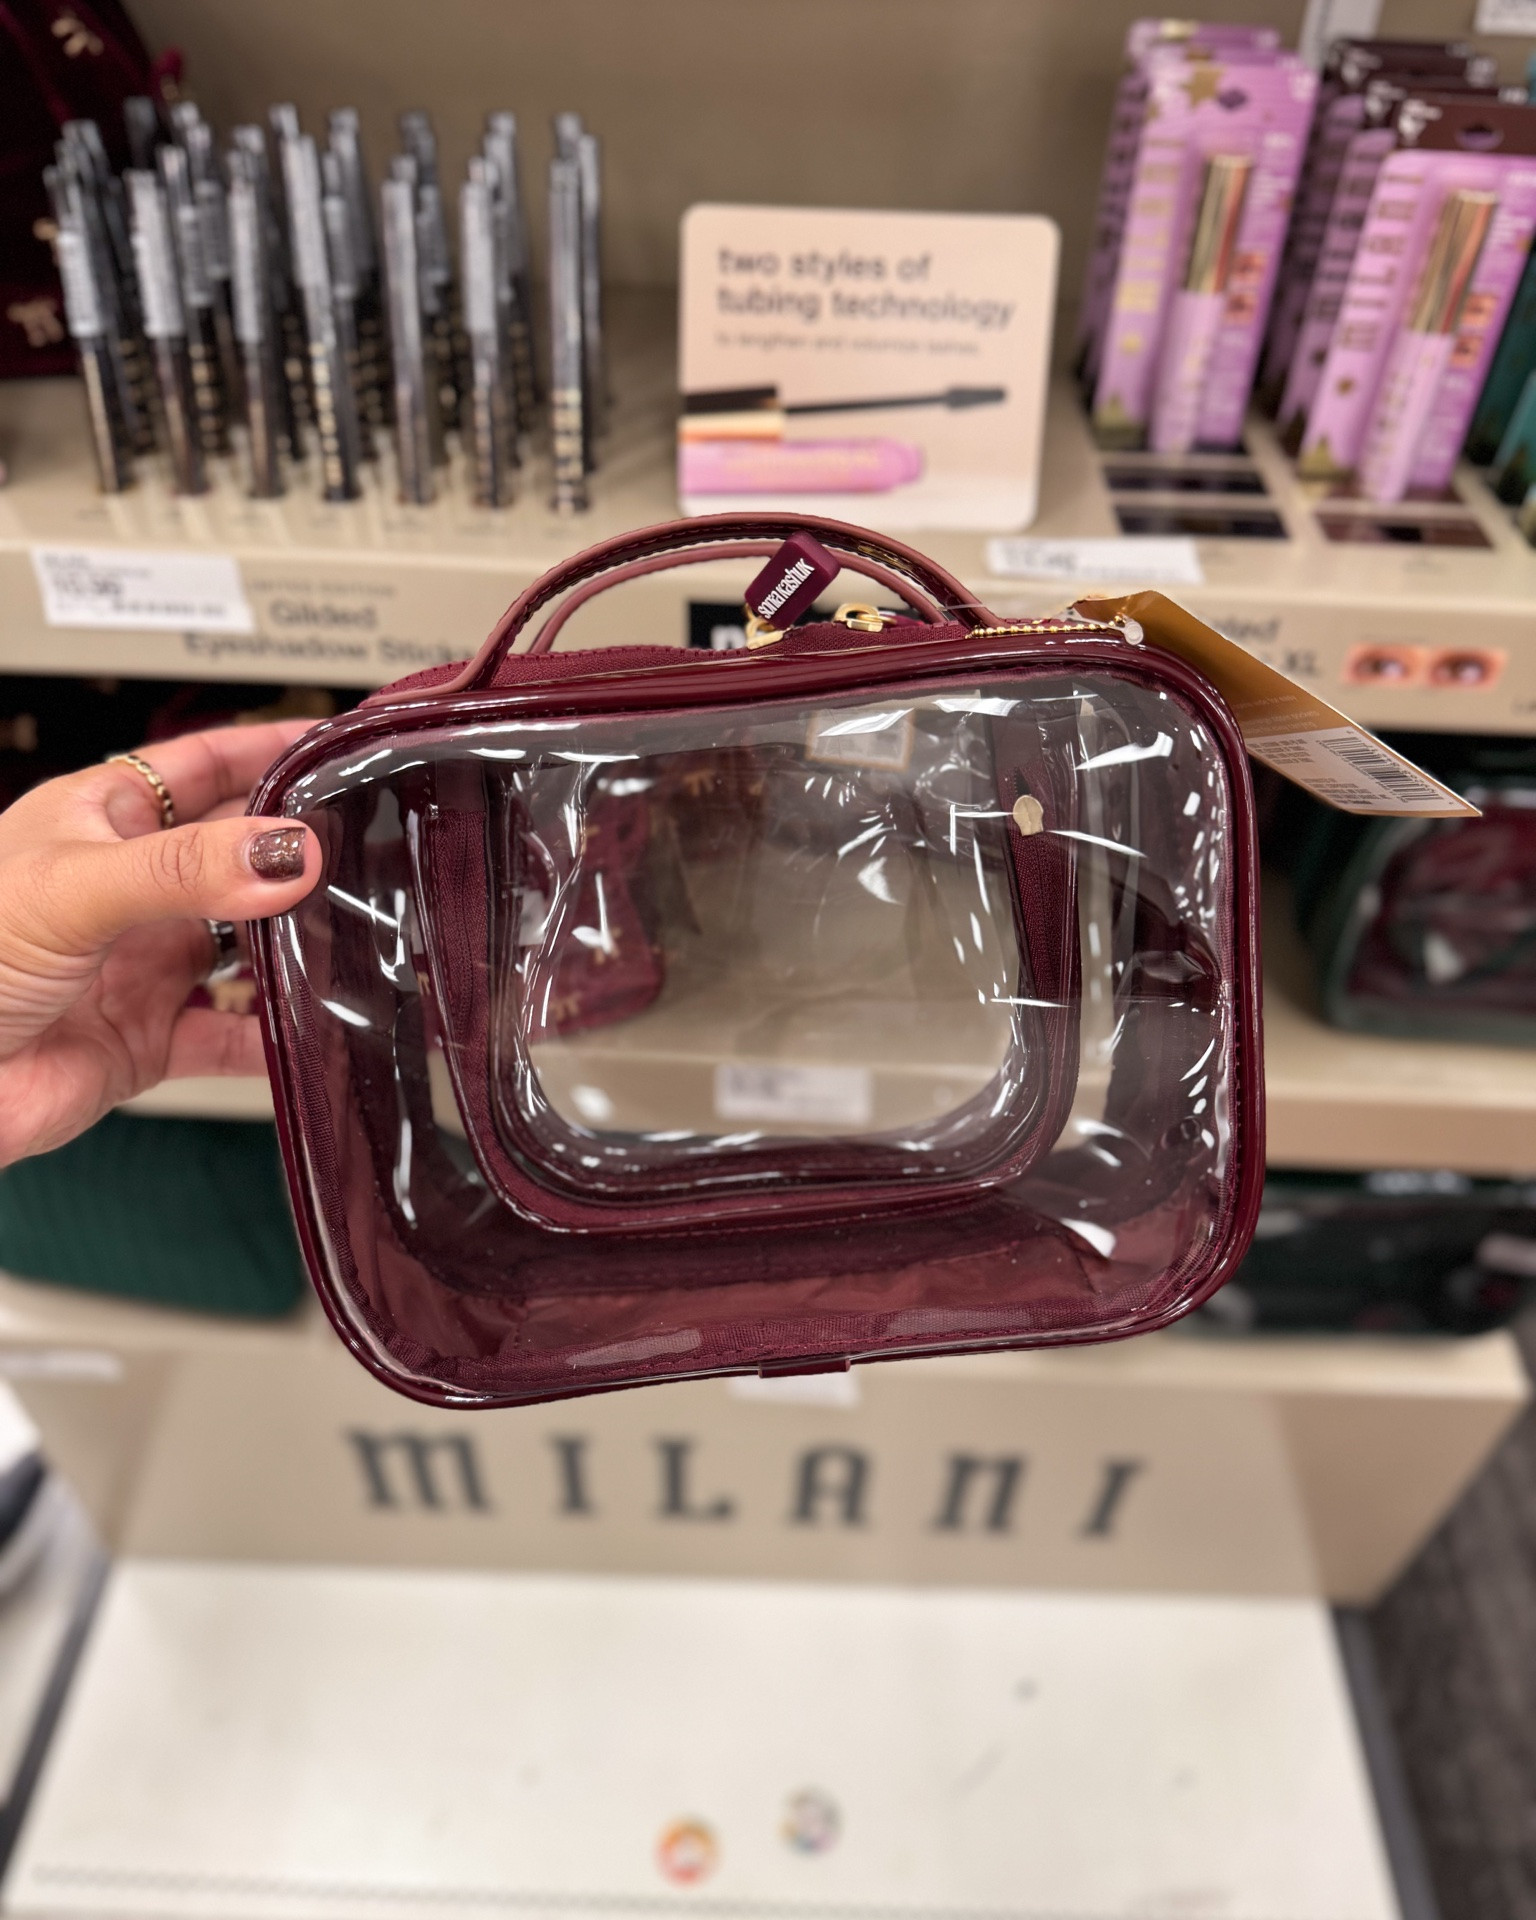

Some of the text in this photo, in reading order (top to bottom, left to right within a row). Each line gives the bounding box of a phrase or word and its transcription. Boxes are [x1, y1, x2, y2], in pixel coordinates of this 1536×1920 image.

[716, 249, 933, 284] two styles of
[716, 287, 1013, 329] tubing technology
[271, 600, 377, 629] Gilded
[345, 1426, 1147, 1541] MILANI
